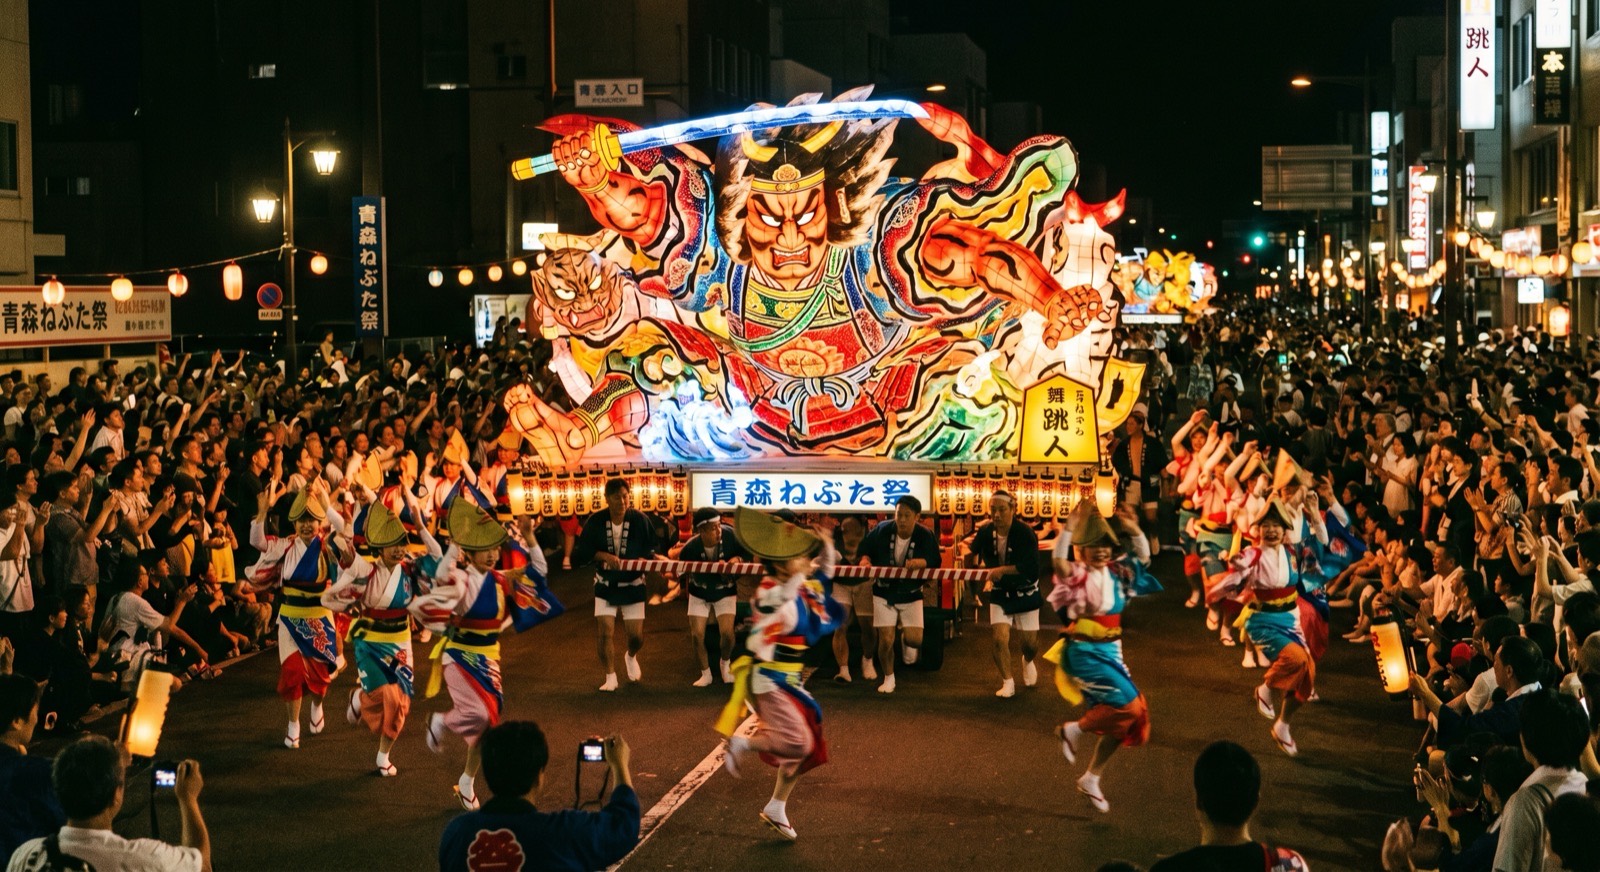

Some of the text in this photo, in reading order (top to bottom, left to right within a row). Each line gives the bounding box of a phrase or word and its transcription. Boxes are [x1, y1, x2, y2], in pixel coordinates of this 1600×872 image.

[1466, 27, 1489, 78] 跳人
[358, 204, 378, 331] 青森ねぶた祭
[2, 300, 108, 334] 青森ねぶた祭
[711, 478, 911, 506] 青森ねぶた祭
